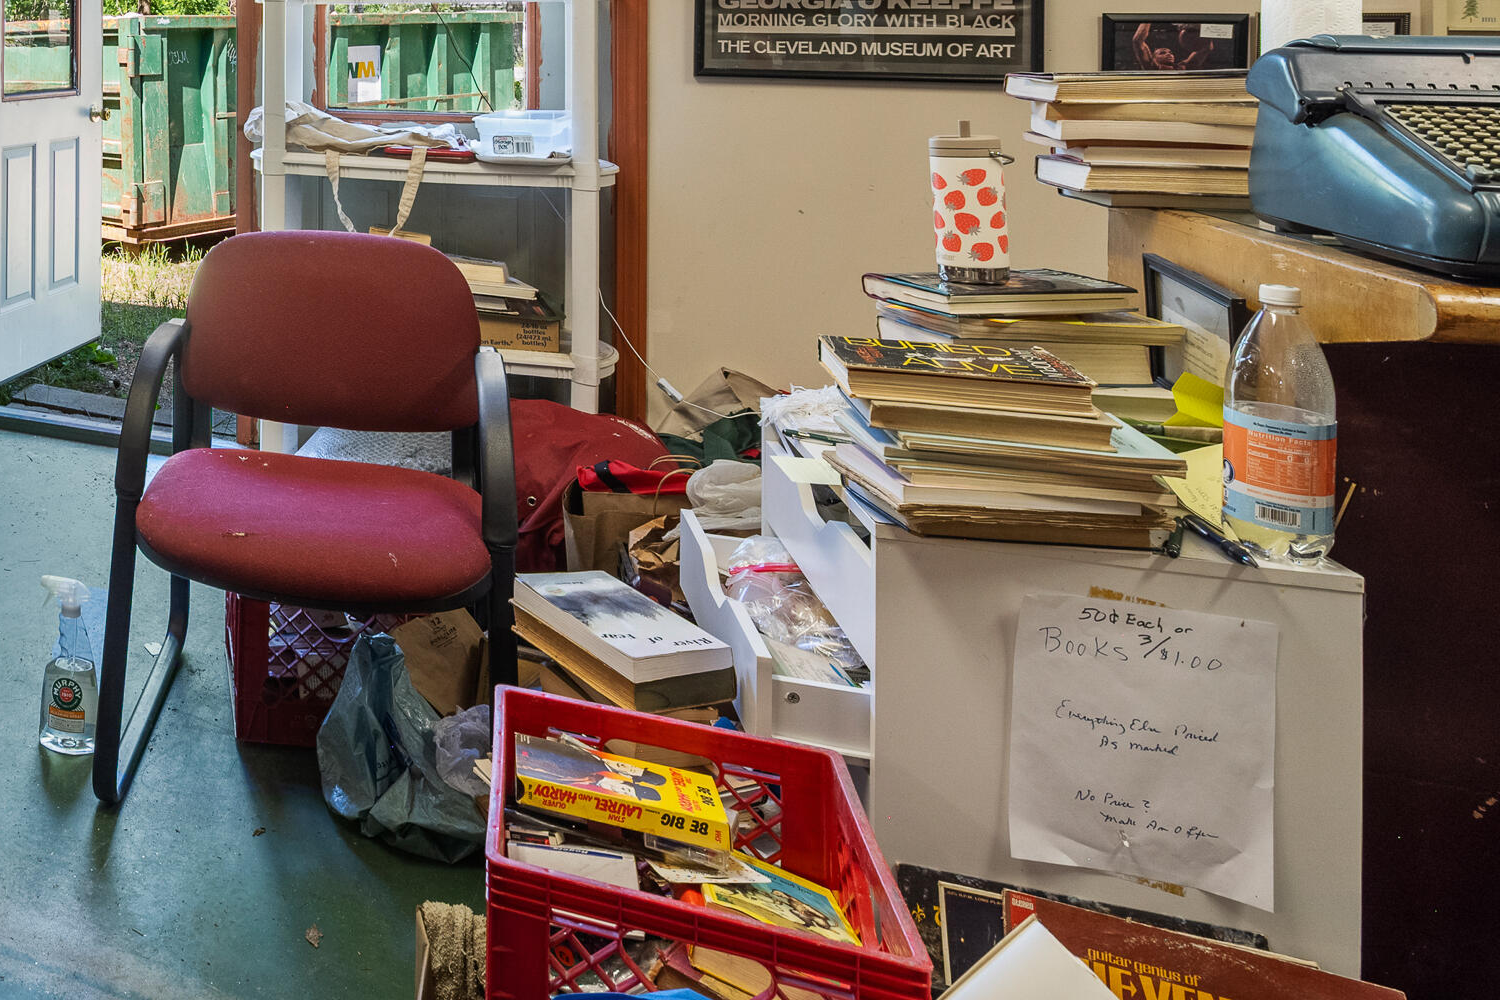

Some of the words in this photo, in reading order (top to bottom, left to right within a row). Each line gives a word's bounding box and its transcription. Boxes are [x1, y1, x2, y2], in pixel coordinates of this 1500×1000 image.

[717, 13, 806, 27] MORNING
[812, 13, 878, 28] GLORY
[884, 14, 937, 28] WITH
[946, 15, 1016, 29] BLACK
[717, 40, 750, 53] THE
[753, 40, 857, 56] CLEVELAND
[861, 42, 942, 57] MUSEUM
[946, 43, 973, 57] OF
[975, 44, 1016, 58] ART
[843, 336, 1013, 357] BURIED
[902, 357, 1043, 377] ALIVE
[1248, 430, 1286, 443] Nutrition
[1288, 437, 1312, 447] Facts
[1078, 607, 1120, 624] 50¢
[1126, 613, 1163, 633] Each
[647, 635, 665, 645] of
[673, 636, 714, 647] River
[1039, 626, 1129, 661] Books
[533, 784, 577, 805] HARDY
[578, 793, 593, 801] AND
[1075, 789, 1096, 801] No
[541, 799, 567, 810] OLIVER
[595, 799, 642, 820] LAUREL
[607, 815, 625, 823] STAN
[661, 812, 685, 830] BIG
[1146, 819, 1168, 831] An
[690, 822, 709, 836] BE
[1087, 948, 1132, 970] guitar
[1134, 961, 1181, 983] genius
[1184, 973, 1202, 988] of
